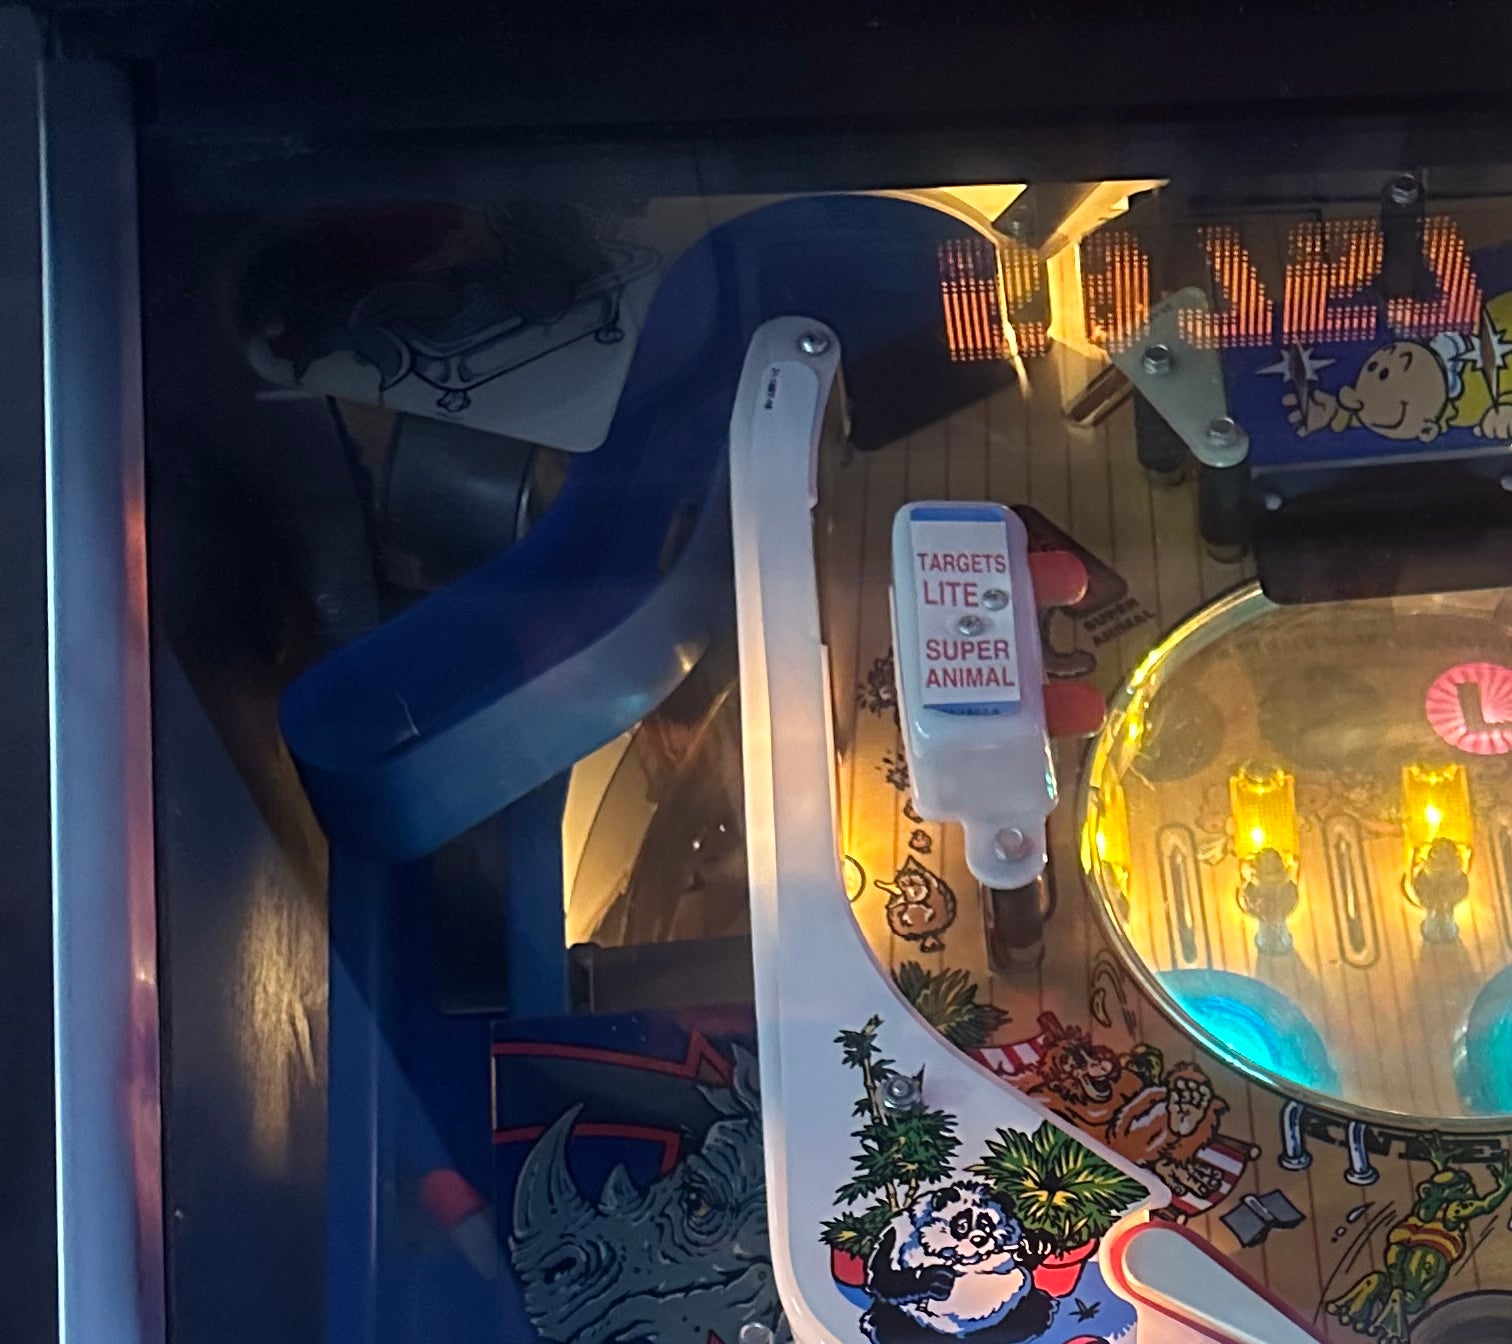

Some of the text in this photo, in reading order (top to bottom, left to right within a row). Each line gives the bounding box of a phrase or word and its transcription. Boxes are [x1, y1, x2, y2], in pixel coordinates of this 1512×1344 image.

[916, 552, 1007, 574] TARGETS
[923, 580, 979, 608] LITE
[925, 638, 1010, 661] SUPER
[925, 667, 1015, 689] ANIMAL
